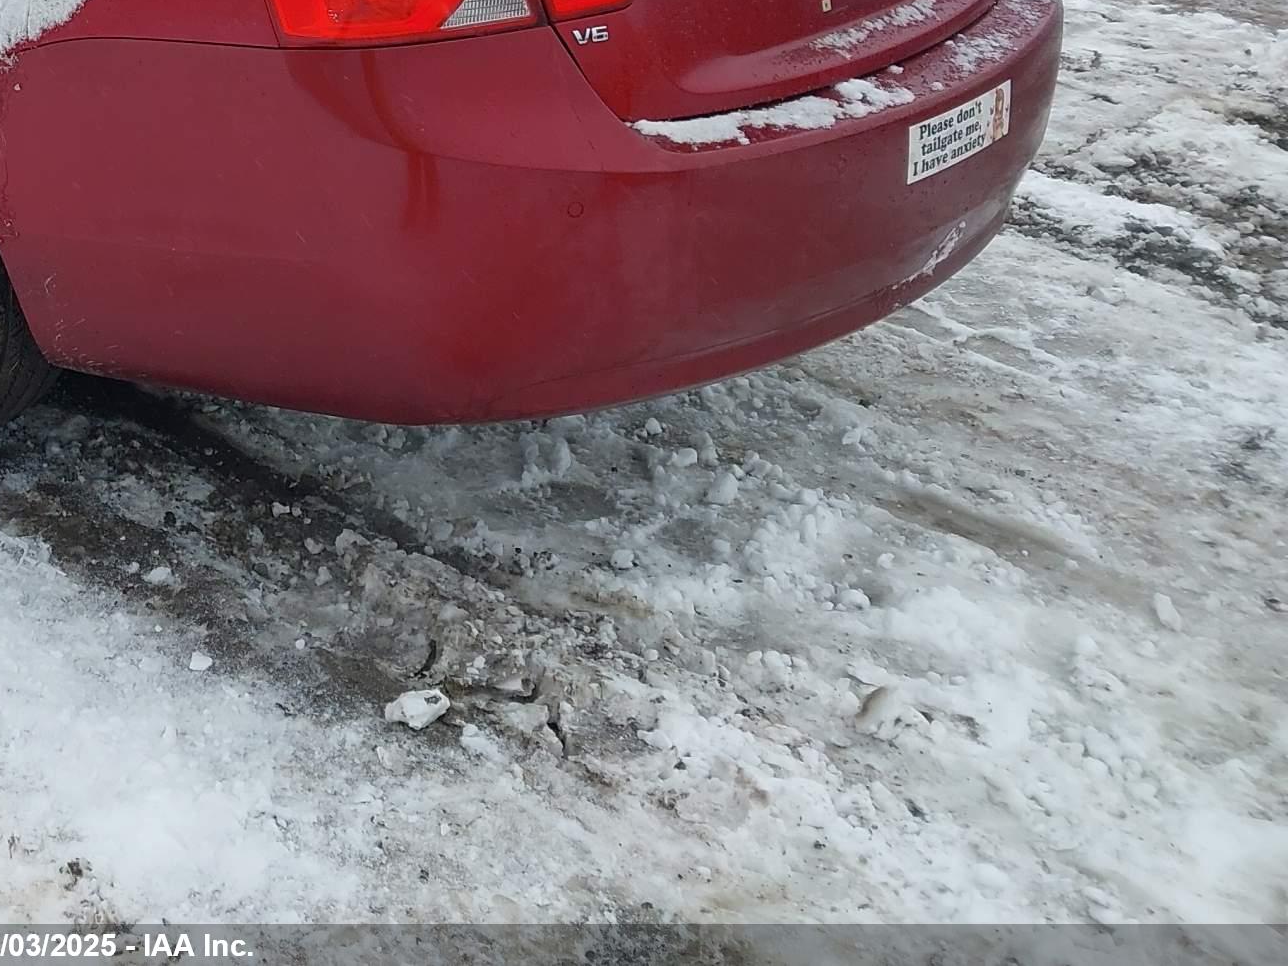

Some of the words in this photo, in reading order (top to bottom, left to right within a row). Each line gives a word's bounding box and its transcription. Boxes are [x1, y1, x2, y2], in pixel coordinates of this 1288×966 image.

[572, 25, 609, 45] V6
[919, 117, 954, 140] Please
[956, 100, 982, 124] don't
[921, 129, 963, 156] tailgate
[965, 120, 982, 137] me,
[912, 161, 918, 176] I
[921, 152, 949, 173] have
[950, 132, 986, 160] anxiety
